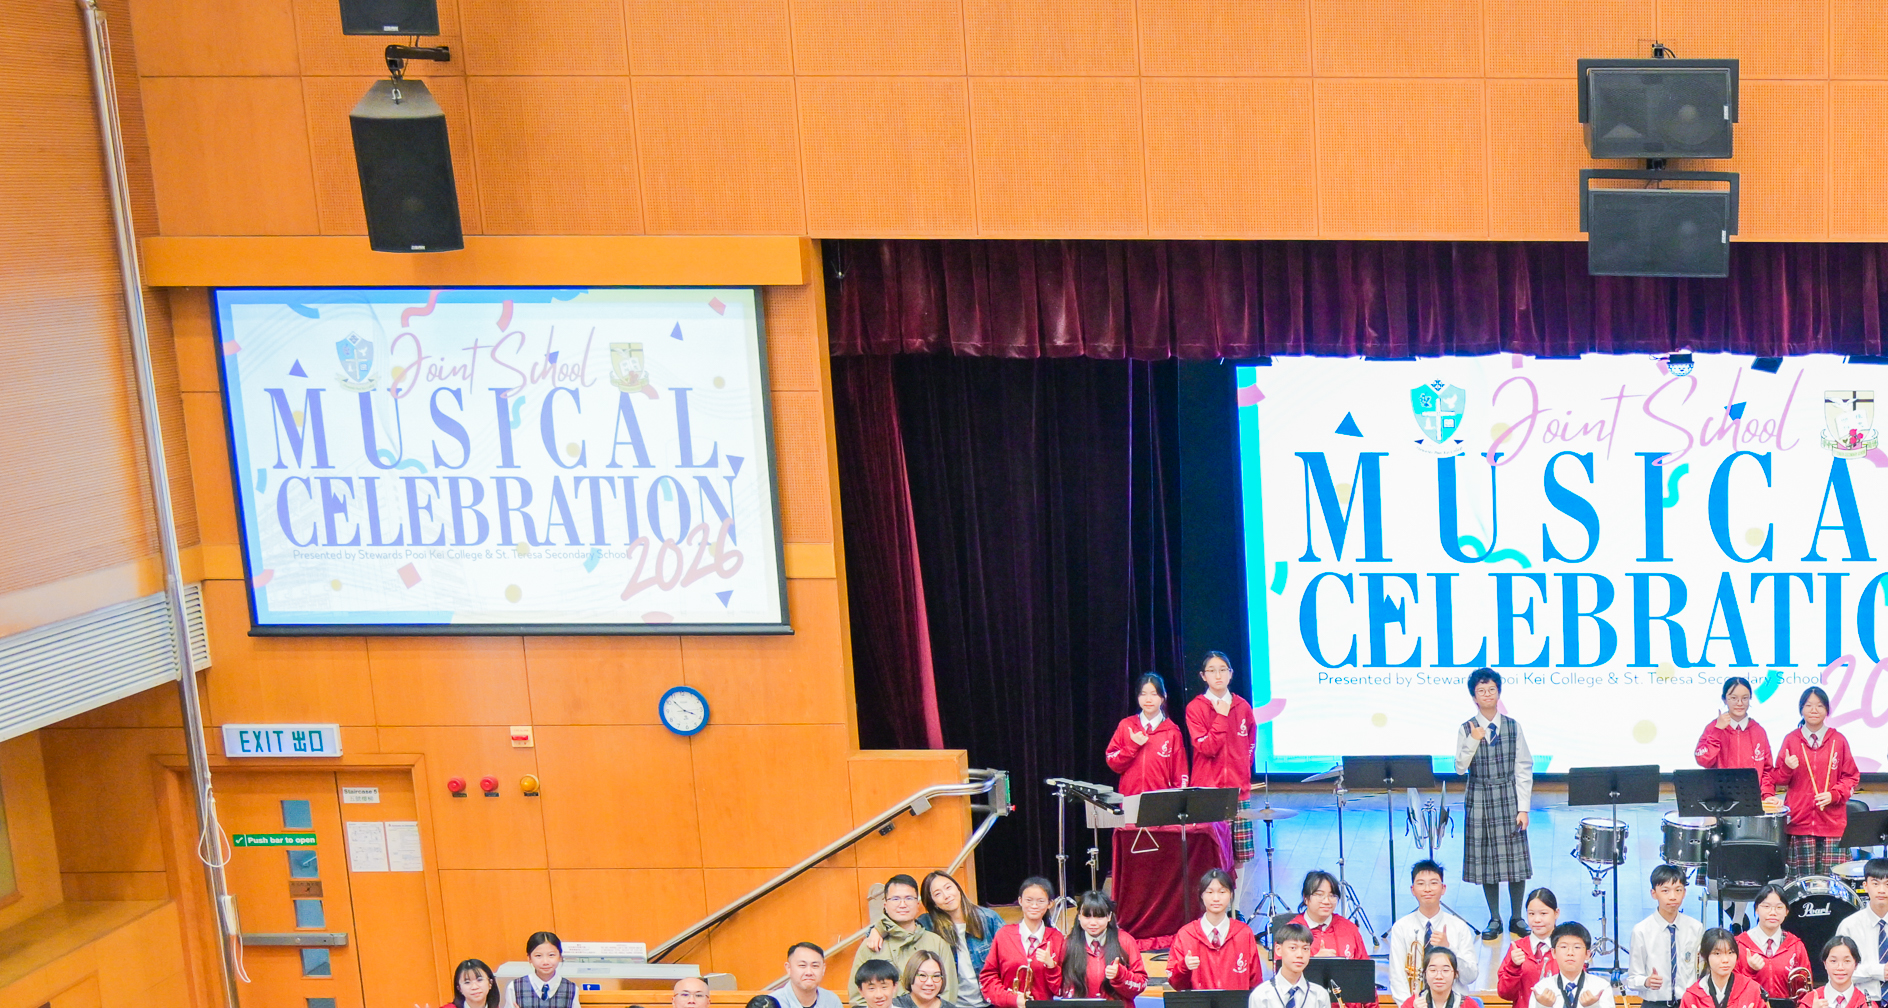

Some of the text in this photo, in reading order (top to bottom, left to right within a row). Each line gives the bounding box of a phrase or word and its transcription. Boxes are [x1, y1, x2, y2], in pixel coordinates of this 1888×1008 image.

[390, 325, 597, 399] Joint School
[264, 387, 719, 470] MUSICAL
[1486, 366, 1804, 467] Joint School
[276, 475, 738, 547] CELEBRATION
[293, 549, 629, 561] Presented by Stewards Pooi Kei College & St. Teresa Secondary School
[620, 517, 744, 601] 2026
[1318, 672, 1392, 685] Presented
[1396, 672, 1411, 688] by
[1416, 672, 1467, 685] Stewar
[1524, 672, 1545, 685] Kei
[1550, 672, 1602, 688] College
[1607, 672, 1619, 684] &
[1624, 672, 1643, 684] St.
[1648, 672, 1693, 684] Teresa
[1776, 671, 1823, 684] School
[239, 730, 324, 753] EXIT 出口
[247, 836, 316, 846] Push bar to open
[1798, 902, 1832, 918] Pearl
